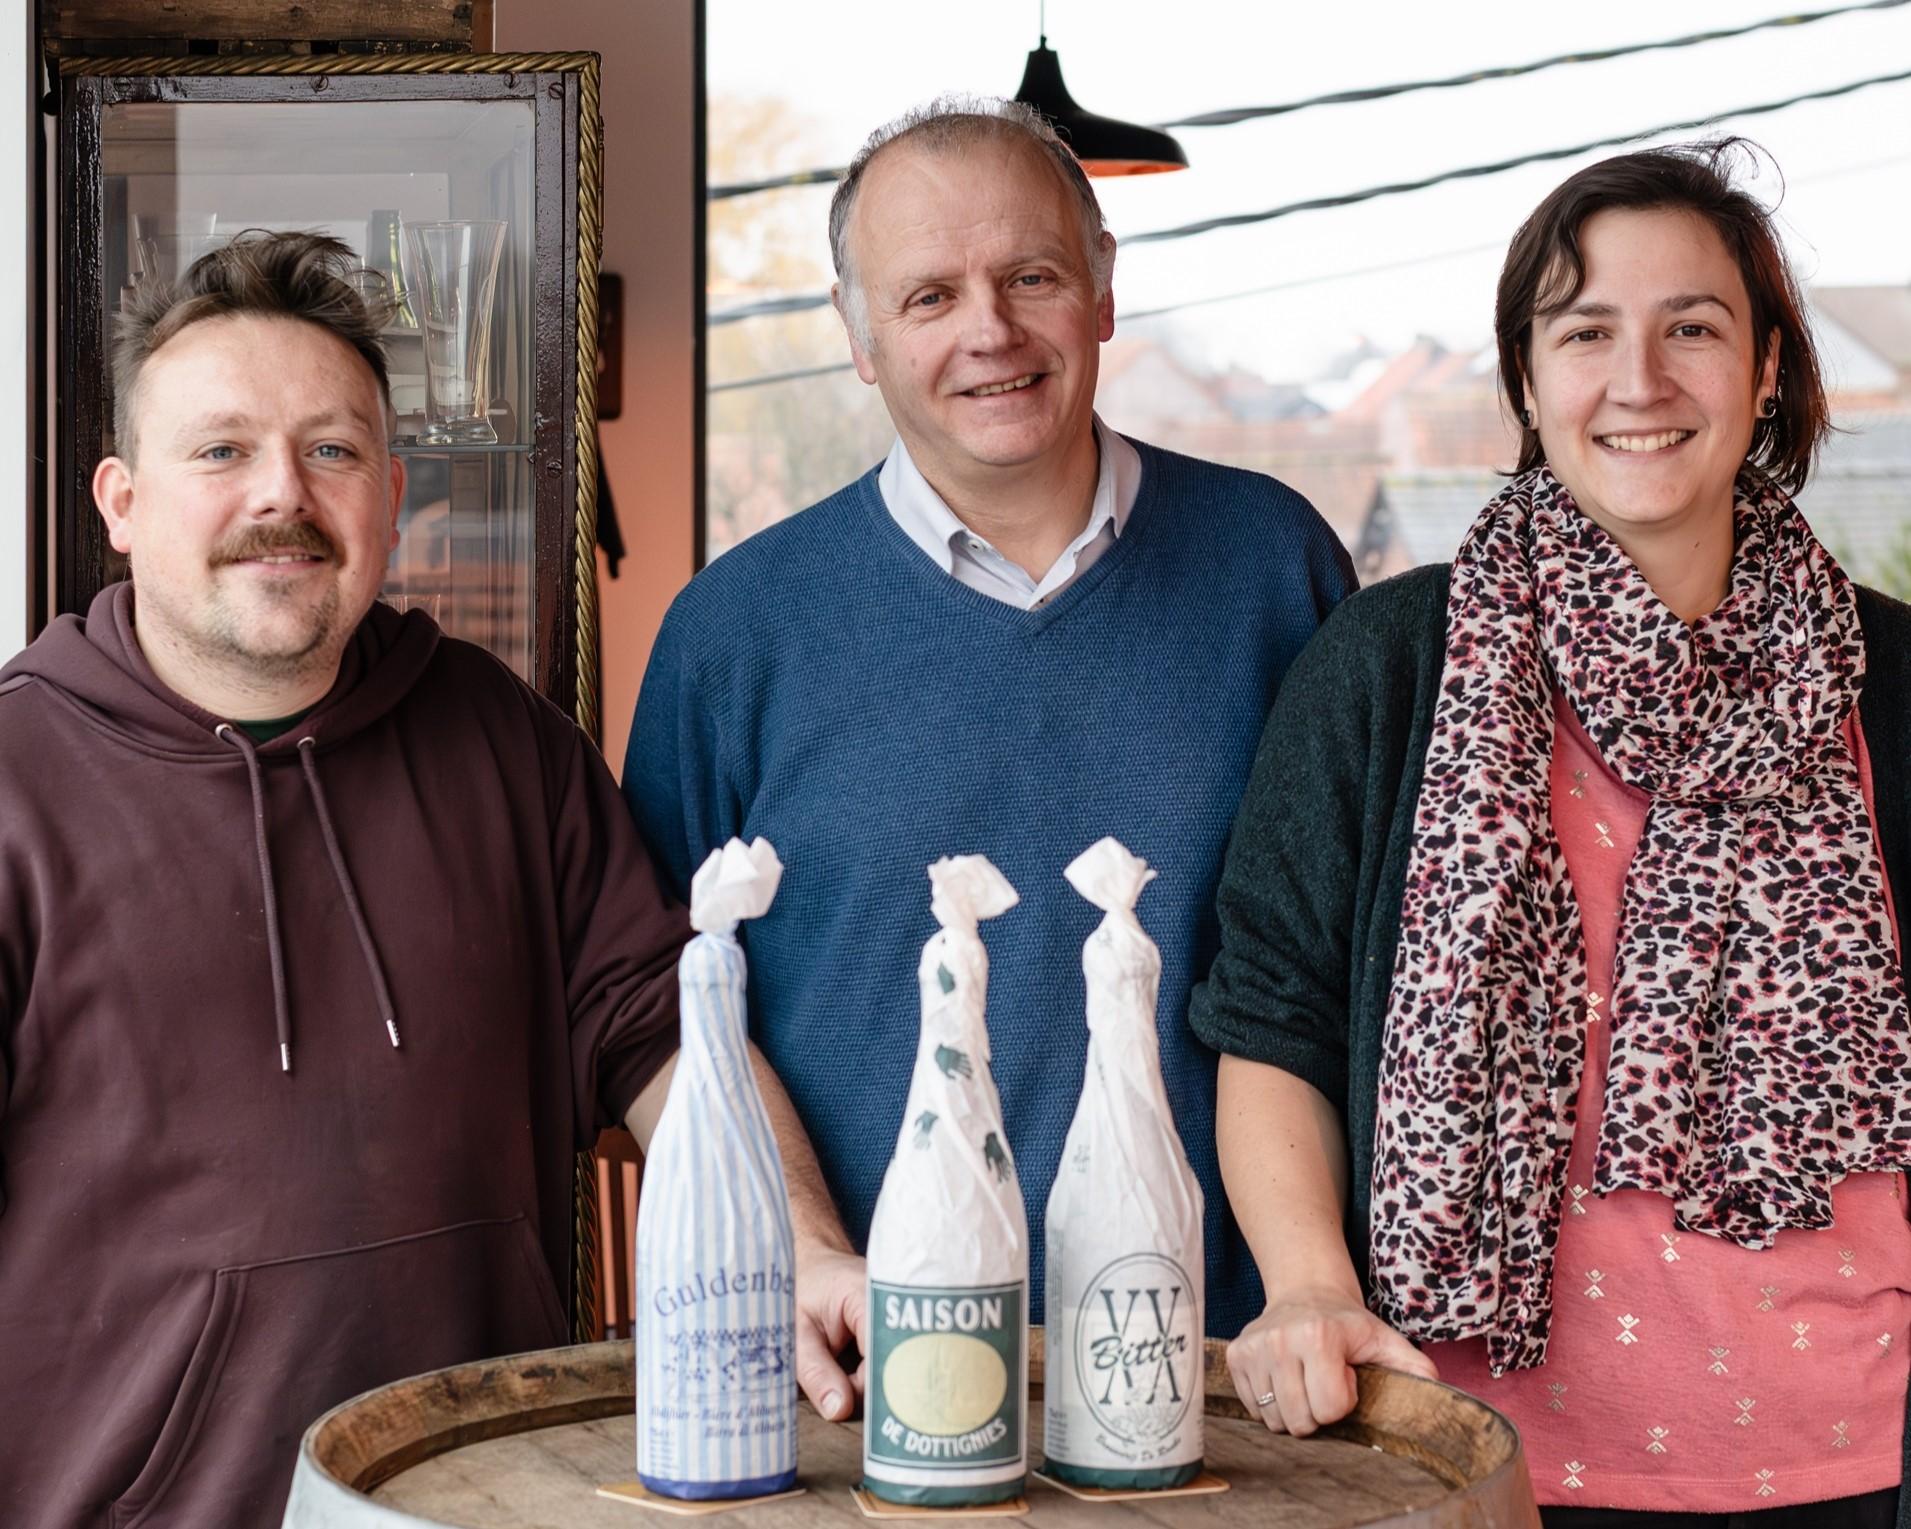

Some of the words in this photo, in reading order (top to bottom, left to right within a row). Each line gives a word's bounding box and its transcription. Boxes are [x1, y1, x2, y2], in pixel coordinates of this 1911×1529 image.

[885, 1294, 1003, 1331] SAISON
[1090, 1334, 1188, 1370] Bitter
[881, 1415, 904, 1446] DE
[904, 1417, 1008, 1457] DOTTIGNIES
